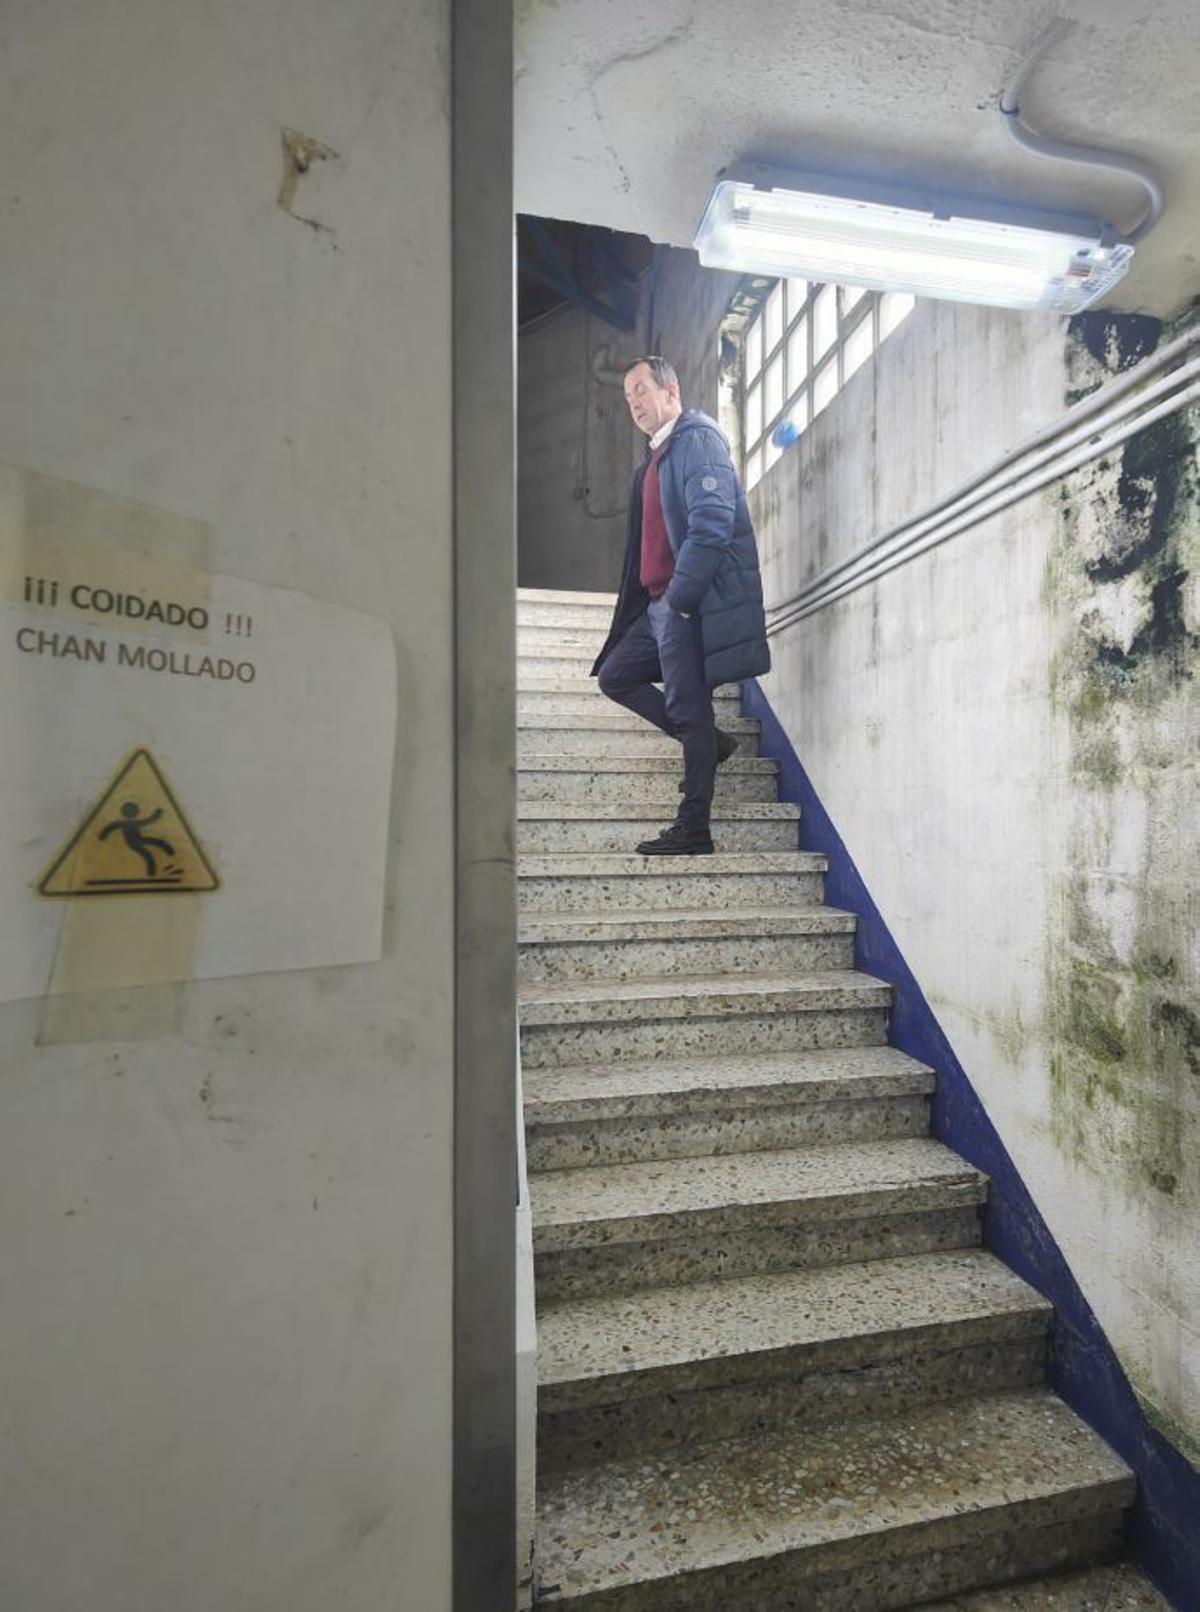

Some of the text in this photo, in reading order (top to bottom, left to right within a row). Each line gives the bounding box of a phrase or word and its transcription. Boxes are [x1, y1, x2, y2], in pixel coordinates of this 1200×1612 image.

[71, 585, 209, 630] COIDADO
[225, 613, 253, 637] !!!
[16, 627, 256, 683] CHAN MOLLADO
